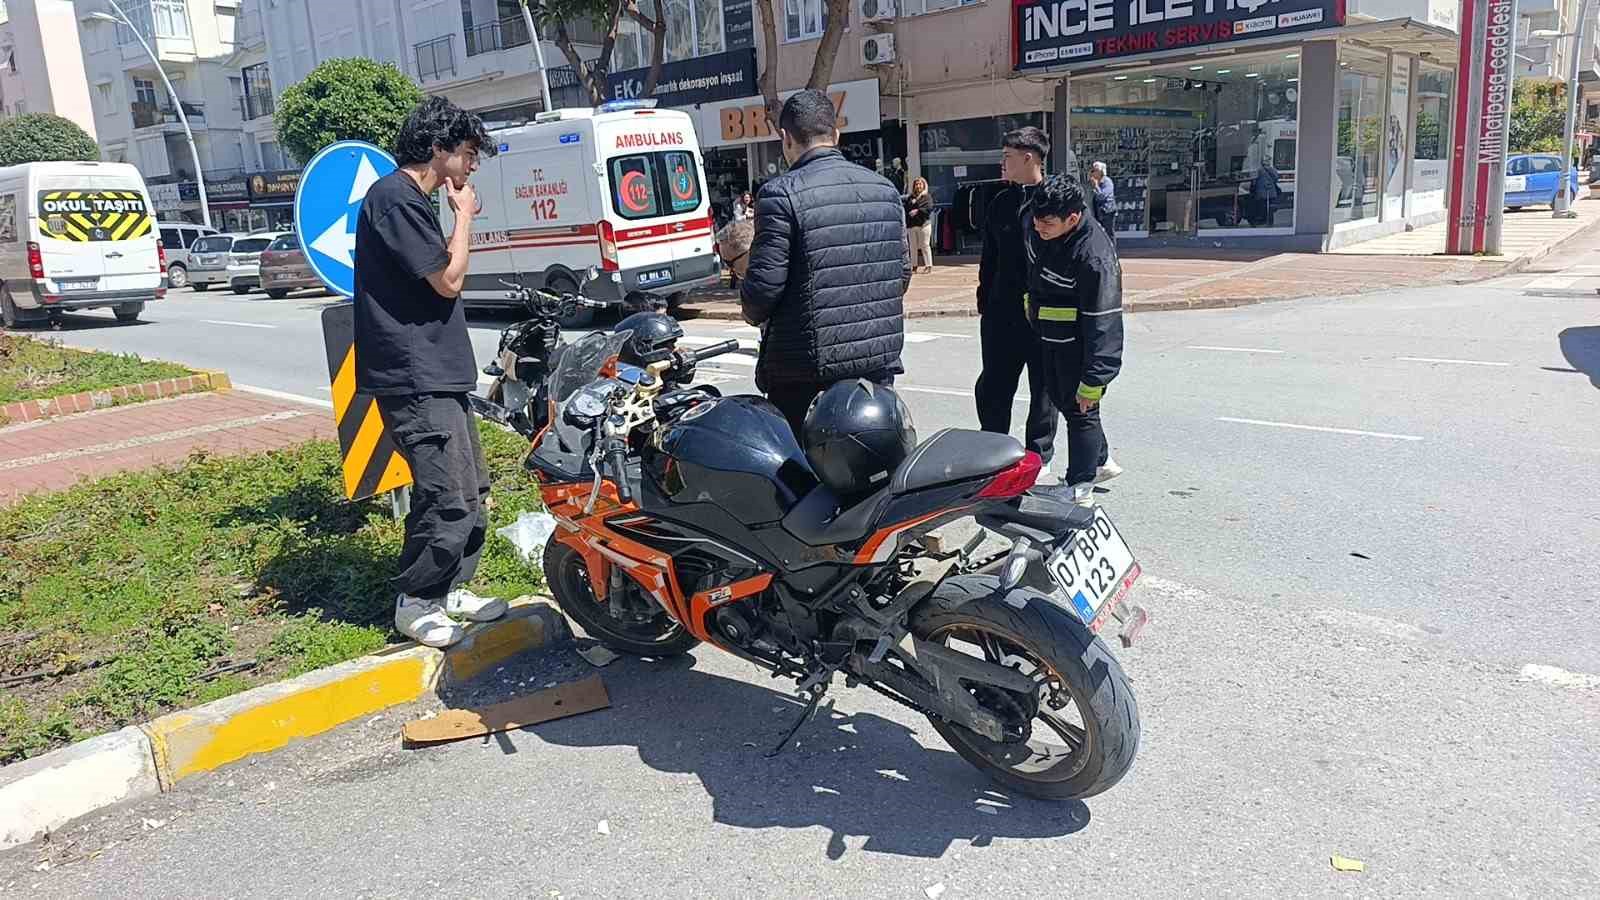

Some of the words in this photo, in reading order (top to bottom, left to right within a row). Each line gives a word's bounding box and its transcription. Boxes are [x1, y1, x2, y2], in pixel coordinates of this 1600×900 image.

[1025, 0, 1114, 41] İNCE
[1061, 44, 1092, 57] SAMSUNG
[679, 76, 719, 91] dekorasyon
[616, 131, 684, 149] AMBULANS
[629, 183, 648, 201] 112
[43, 200, 92, 212] OKUL
[93, 199, 144, 213] TAŞITI
[531, 198, 558, 220] 112
[1057, 549, 1081, 588] 07
[1076, 516, 1112, 562] BPD
[1085, 556, 1116, 600] 123
